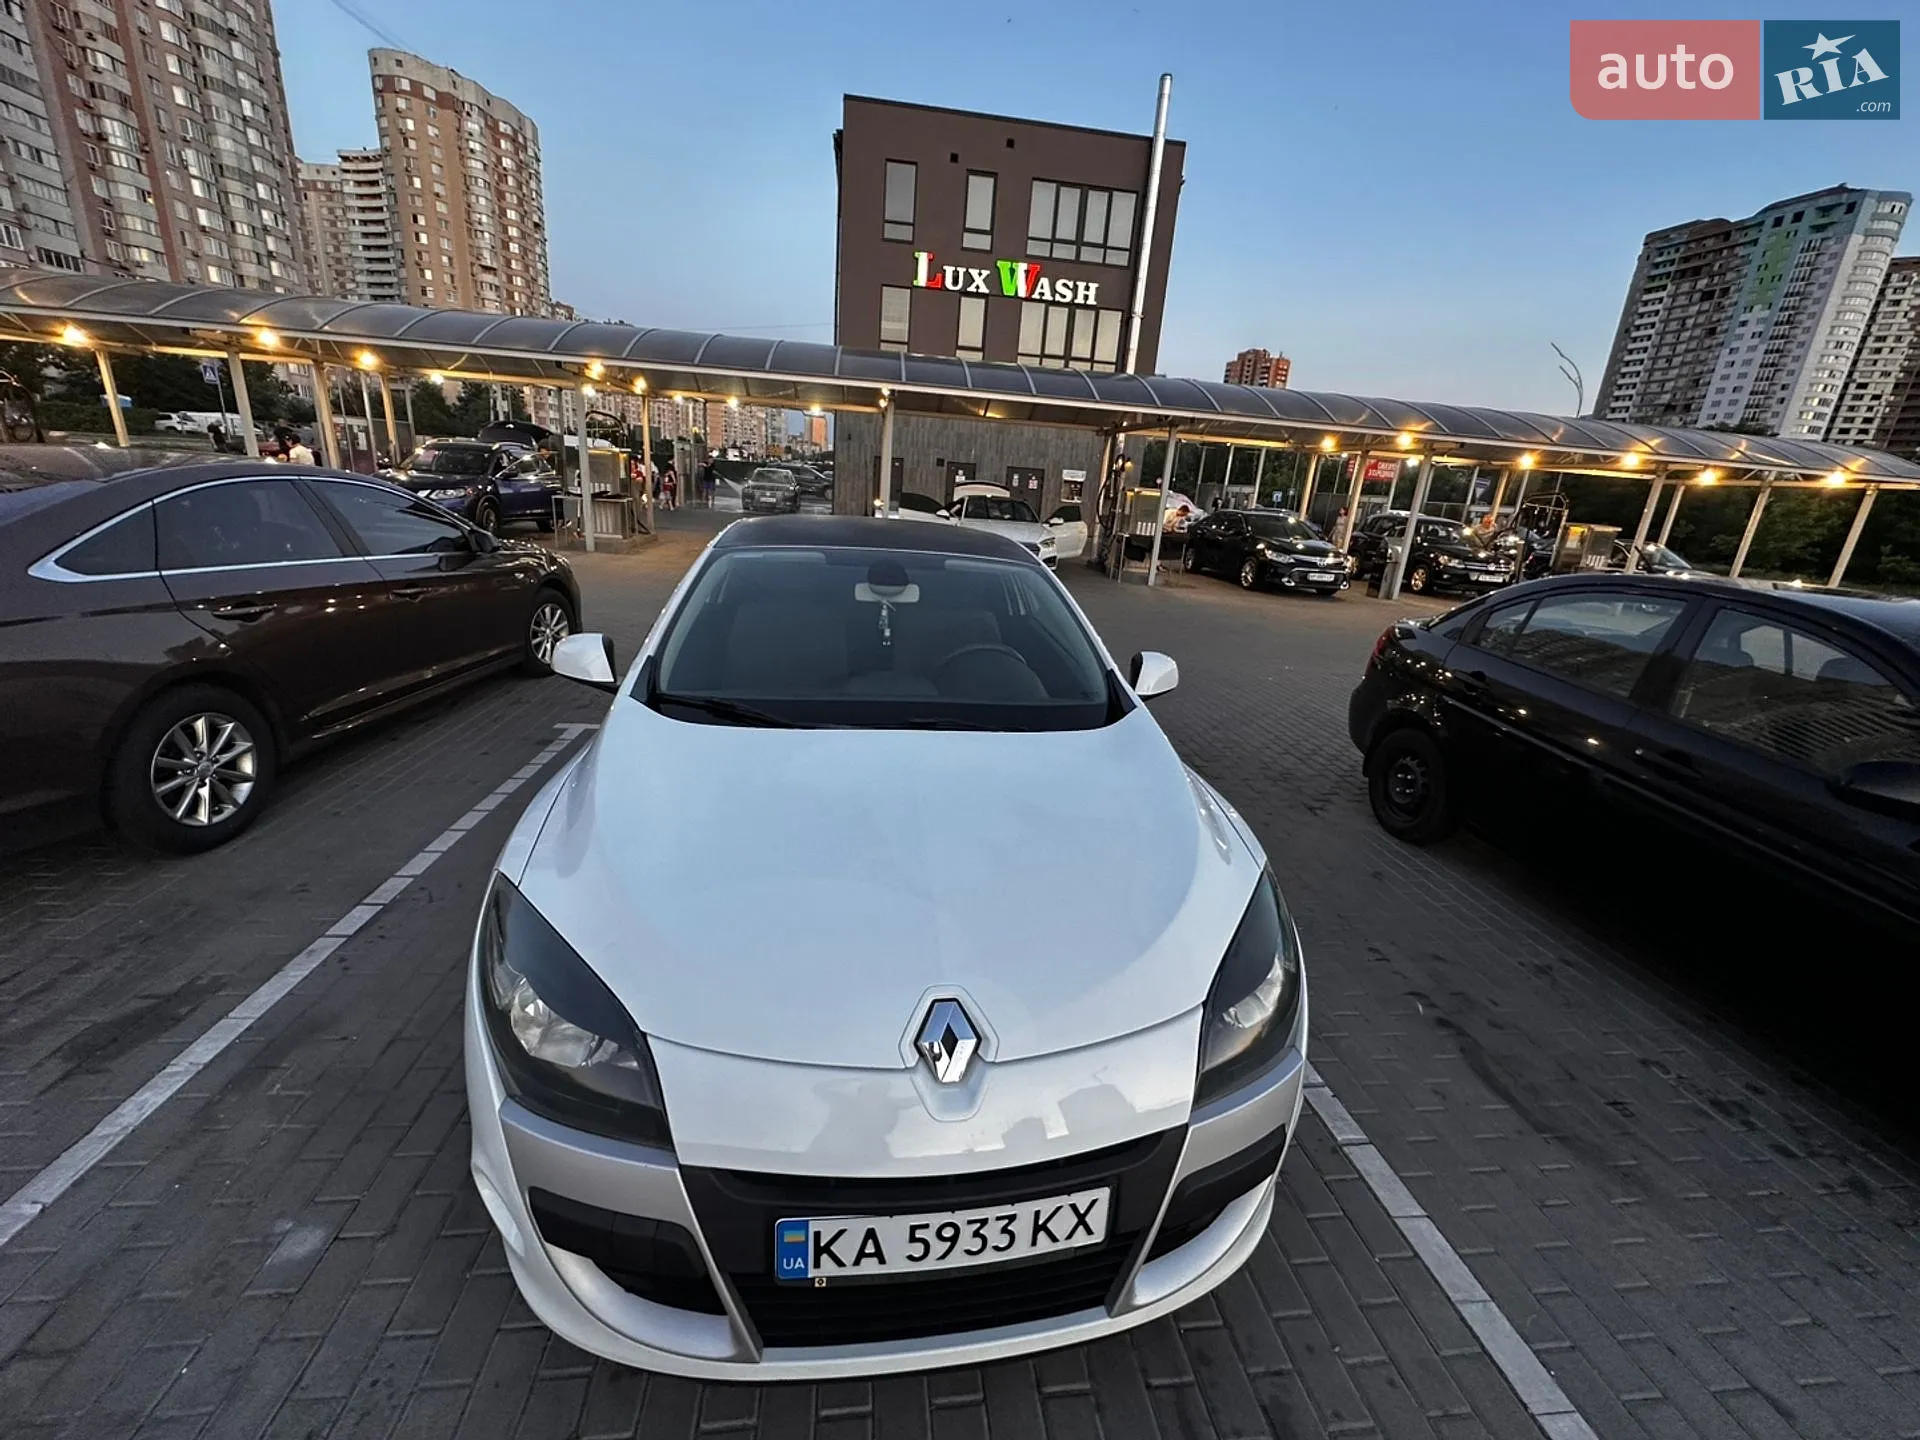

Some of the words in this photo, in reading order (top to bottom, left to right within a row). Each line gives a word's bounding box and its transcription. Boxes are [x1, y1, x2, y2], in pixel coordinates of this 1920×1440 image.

[813, 1226, 887, 1270] KA
[906, 1213, 1018, 1262] 5933
[1030, 1197, 1099, 1247] KX
[783, 1257, 806, 1270] UA
